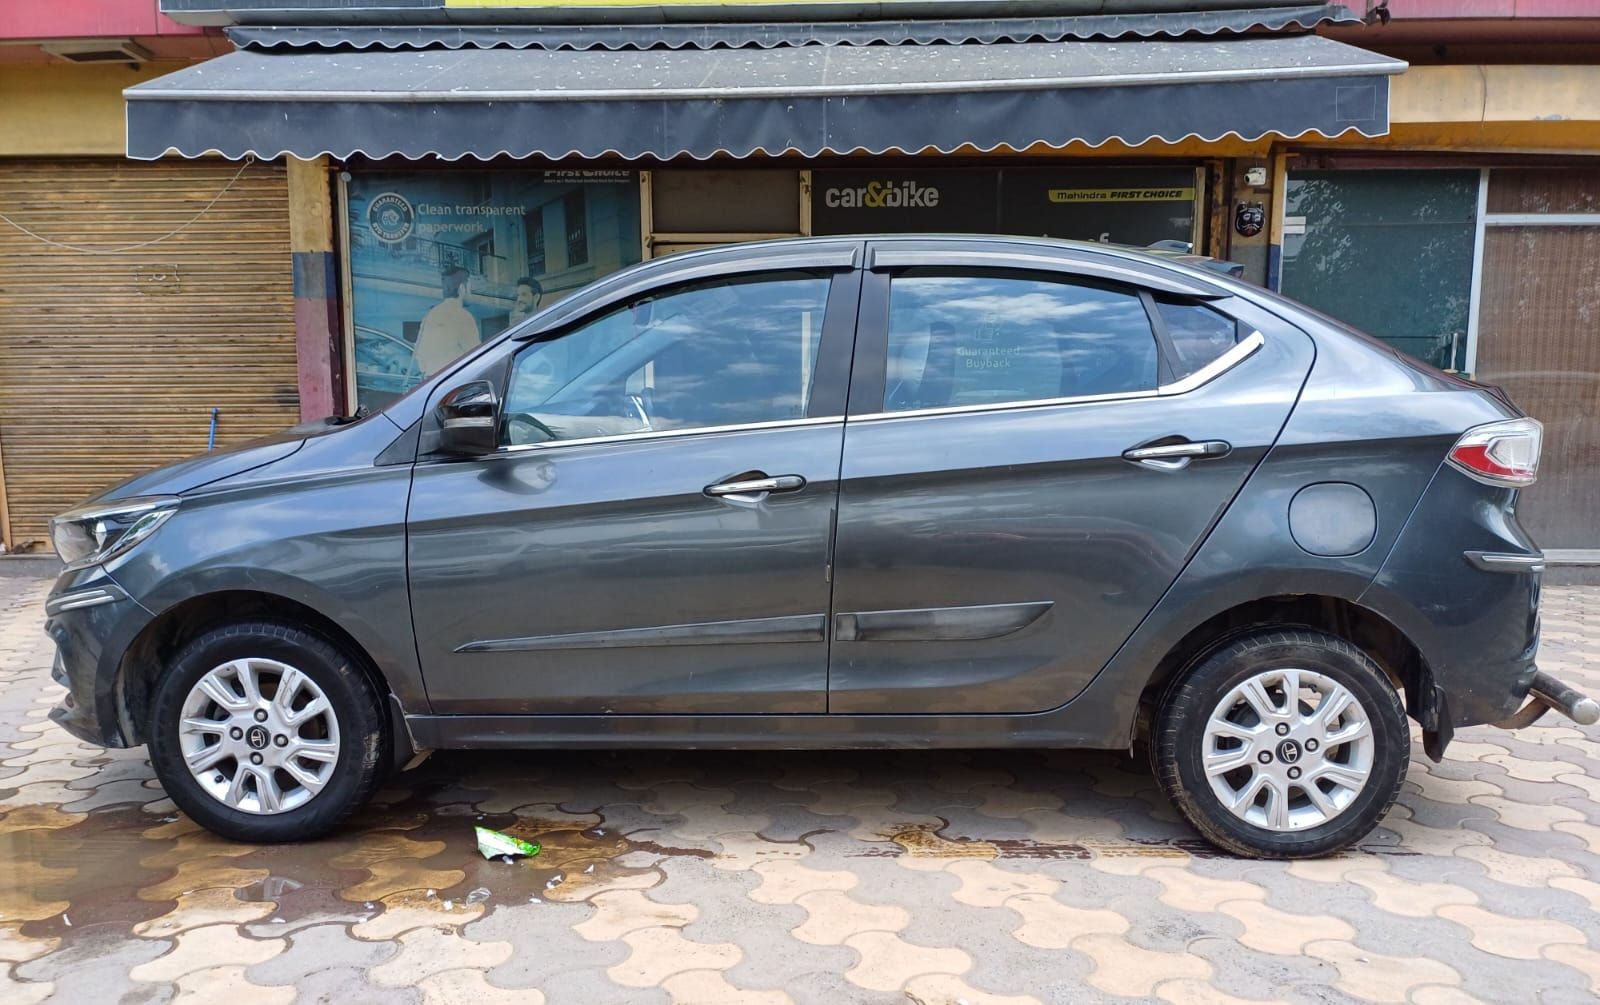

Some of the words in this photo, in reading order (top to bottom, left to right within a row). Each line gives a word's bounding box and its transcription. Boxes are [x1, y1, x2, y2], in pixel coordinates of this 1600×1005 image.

[825, 180, 940, 208] car&bike
[1057, 191, 1107, 200] Mahindra
[1110, 190, 1141, 199] FIRST
[1143, 190, 1184, 199] CHOICE
[417, 203, 451, 215] Clean
[455, 204, 527, 218] transparent
[417, 222, 488, 234] paperwork.
[957, 346, 1020, 356] Guaranteed
[966, 358, 1010, 370] Buyback
